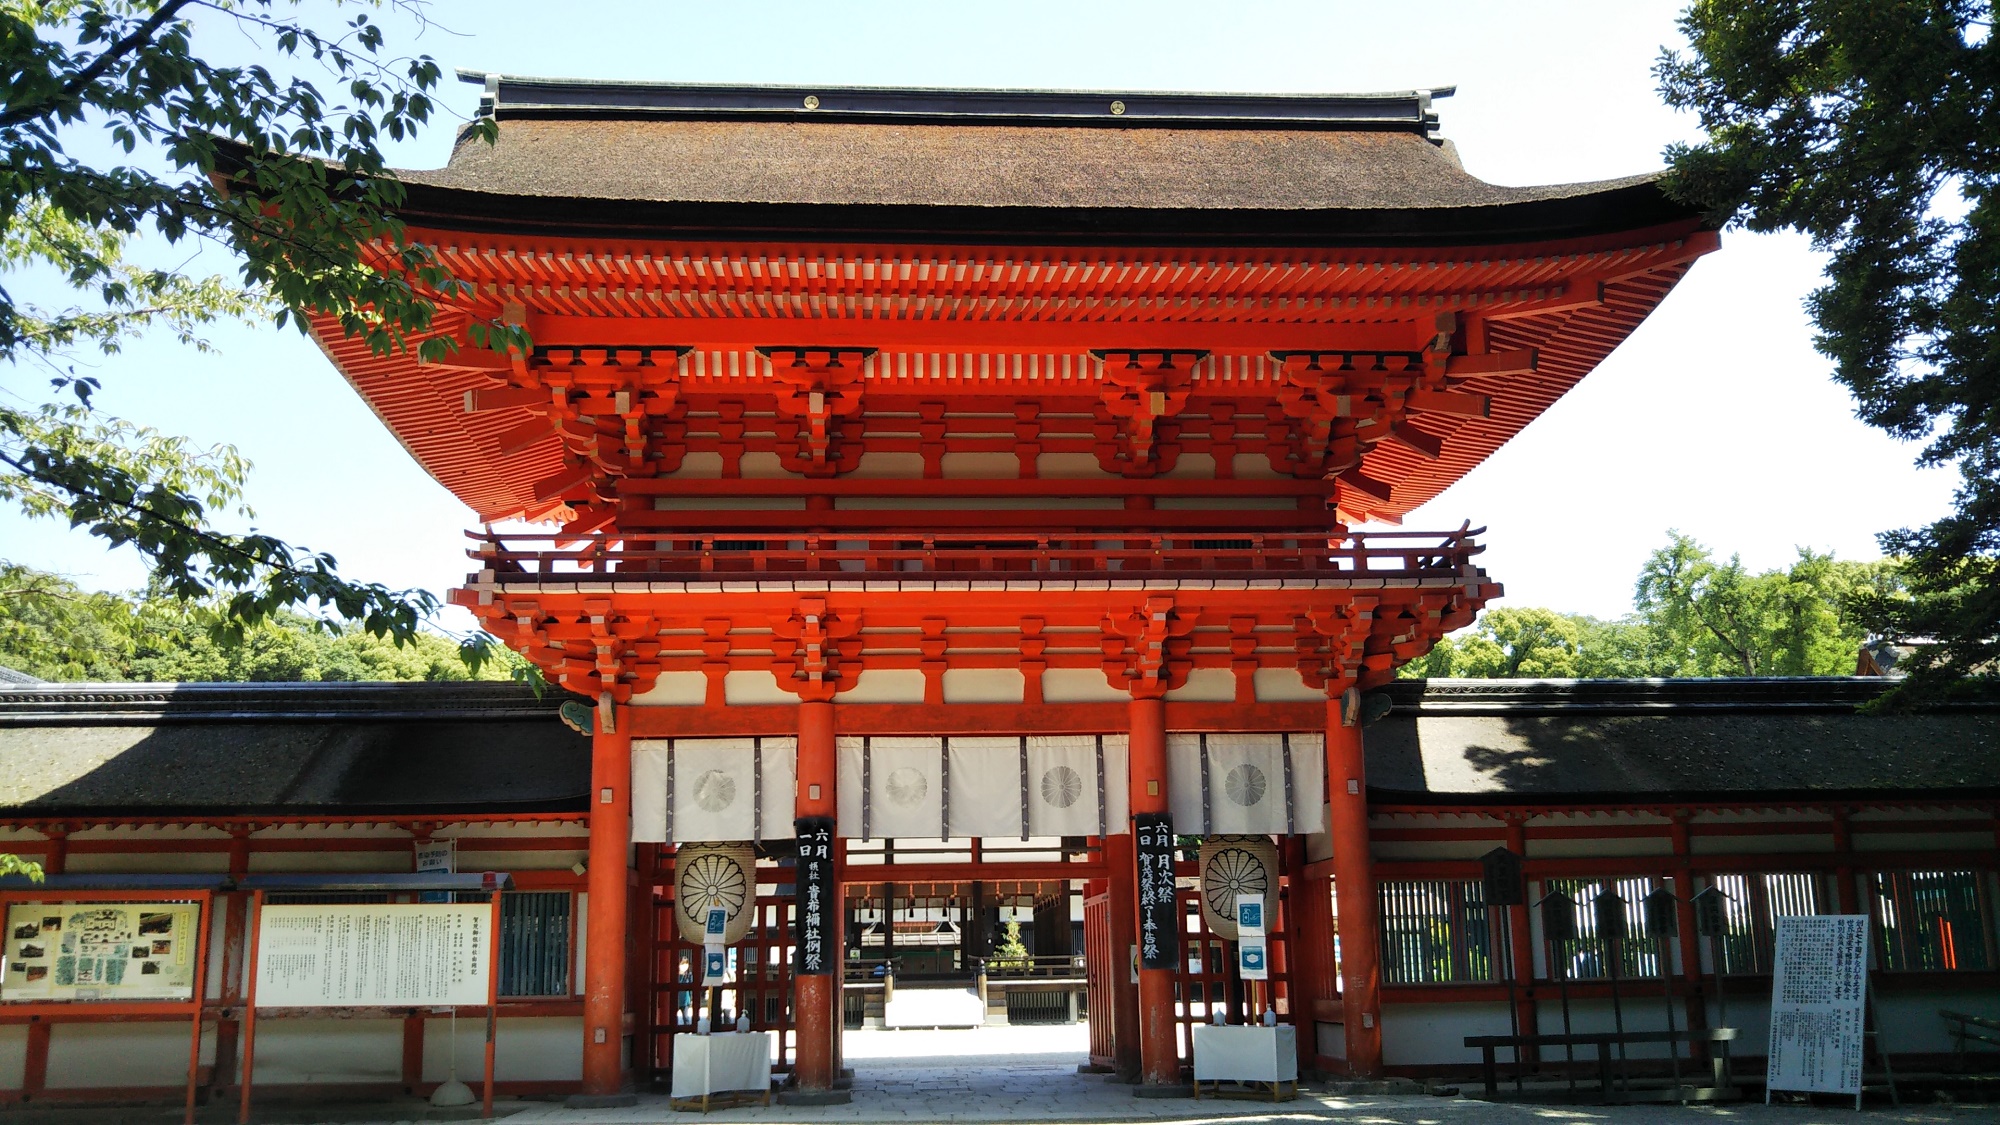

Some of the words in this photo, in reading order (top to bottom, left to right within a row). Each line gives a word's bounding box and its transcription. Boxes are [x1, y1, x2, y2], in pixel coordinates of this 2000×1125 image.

[799, 834, 812, 856] 一日
[815, 828, 828, 859] 六月
[1139, 825, 1152, 846] 一日
[1155, 821, 1168, 848] 六月
[1157, 853, 1174, 904] 月次祭
[1139, 852, 1159, 960] 賀茂祭終了奉告祭
